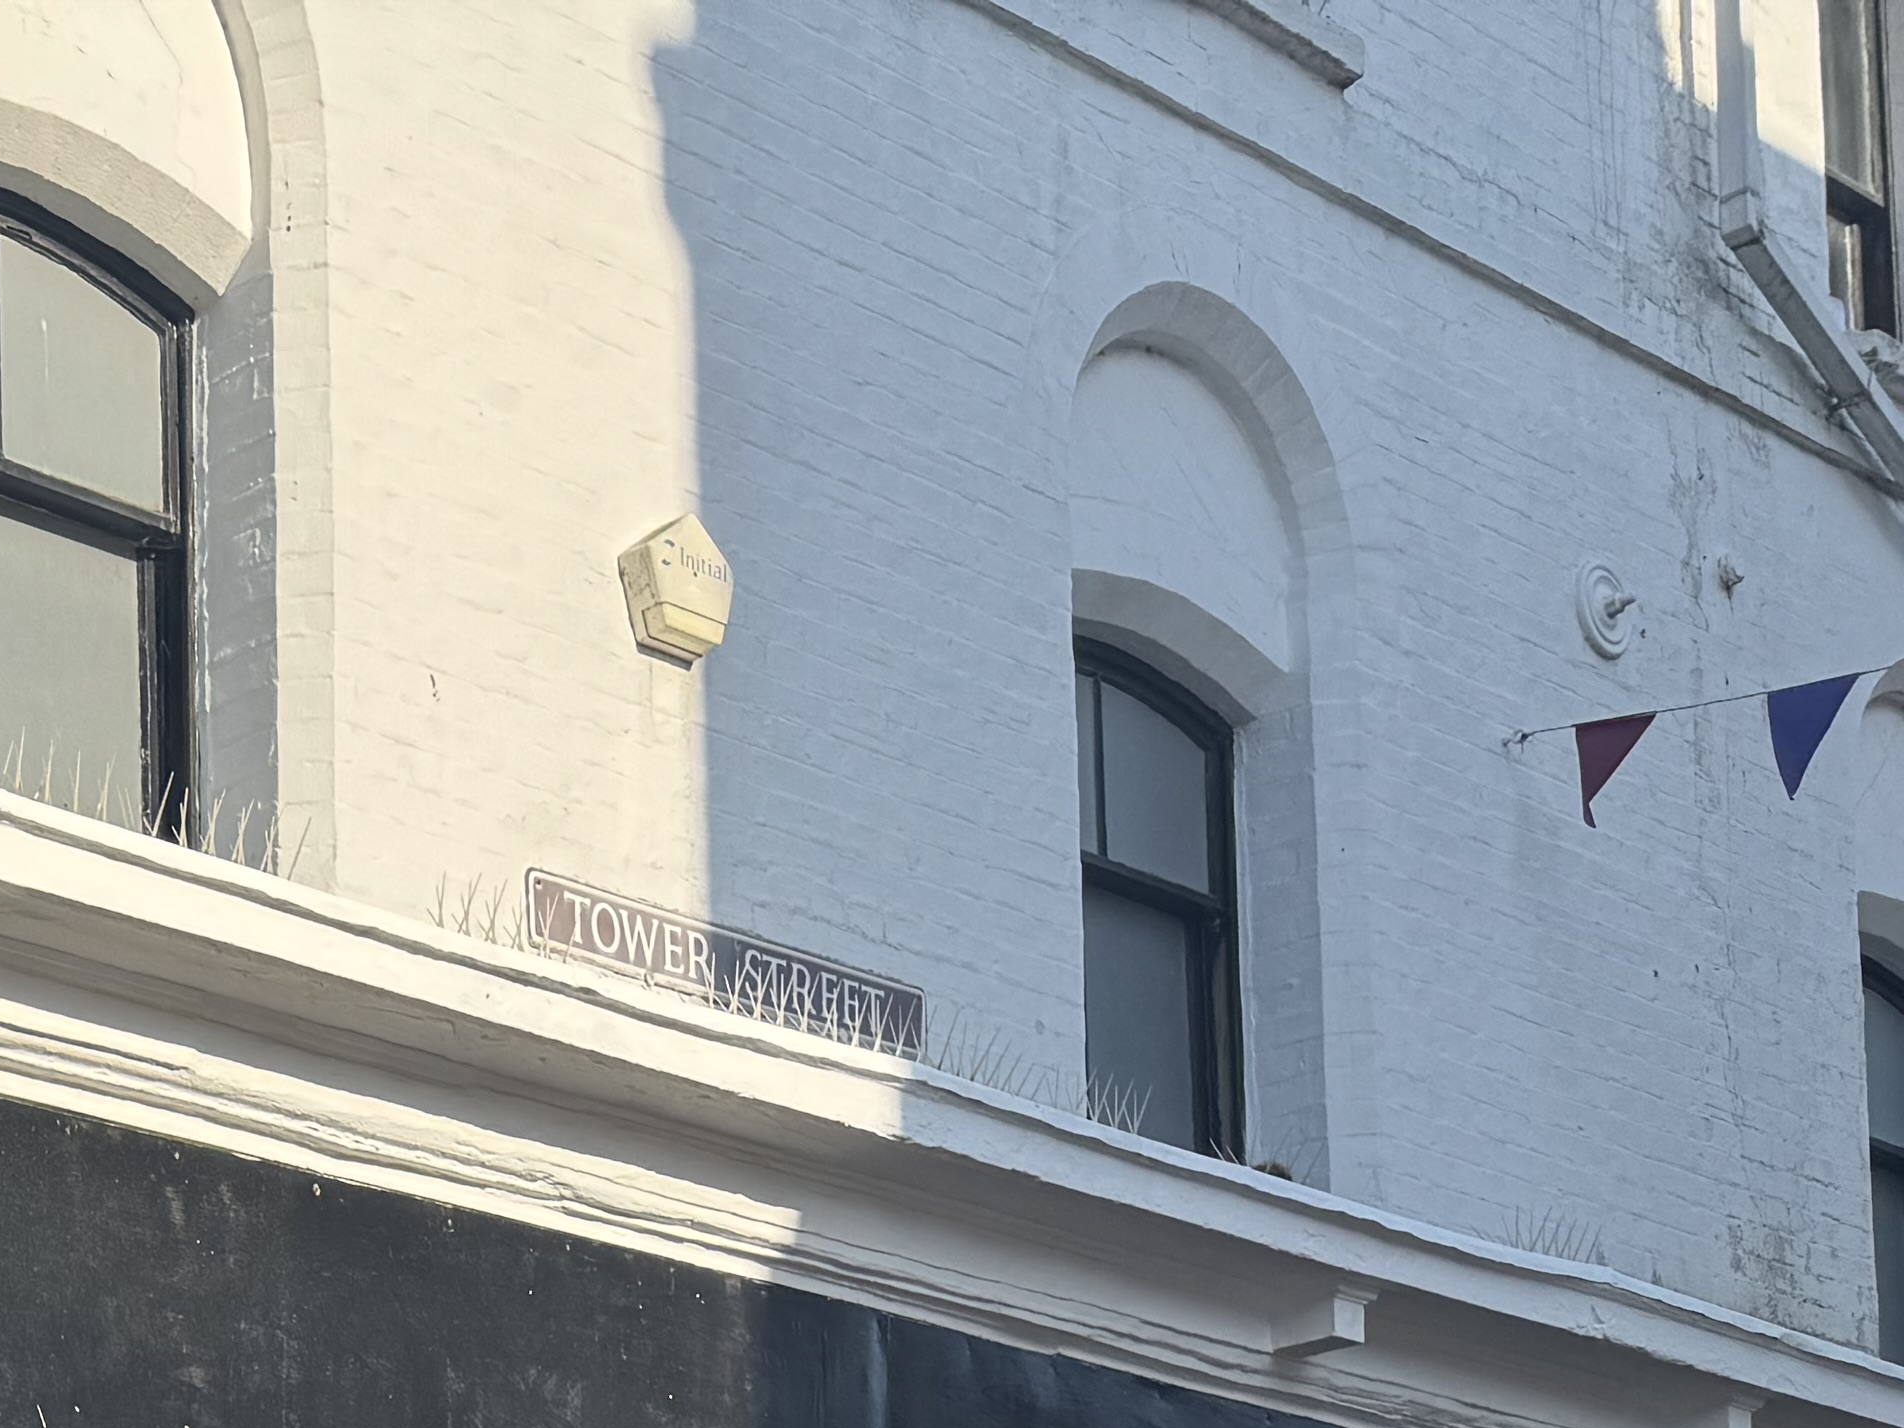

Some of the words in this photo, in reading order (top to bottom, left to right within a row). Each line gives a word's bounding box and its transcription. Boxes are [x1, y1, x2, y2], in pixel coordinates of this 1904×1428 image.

[680, 546, 727, 583] Initial
[564, 891, 711, 980] TOWER
[743, 949, 885, 1034] STREET
